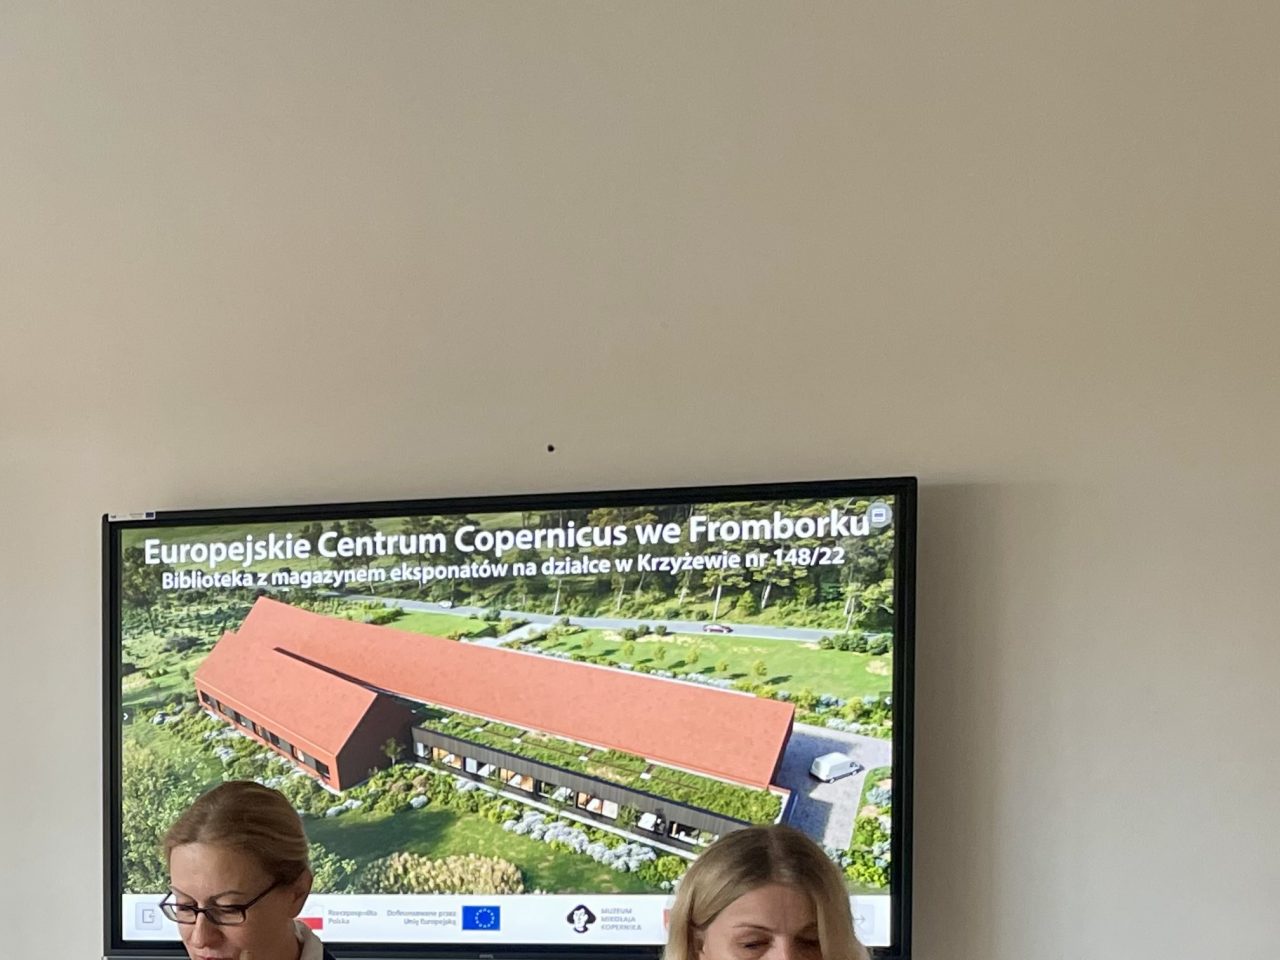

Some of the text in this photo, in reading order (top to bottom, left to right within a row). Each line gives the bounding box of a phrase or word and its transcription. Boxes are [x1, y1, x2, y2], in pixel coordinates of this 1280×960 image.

[144, 508, 871, 568] Europejskie Centrum Copernicus we Fromborku
[162, 546, 845, 593] Biblioteka z magazynem eksponatów na działce w Krzyżewie nr 148/22
